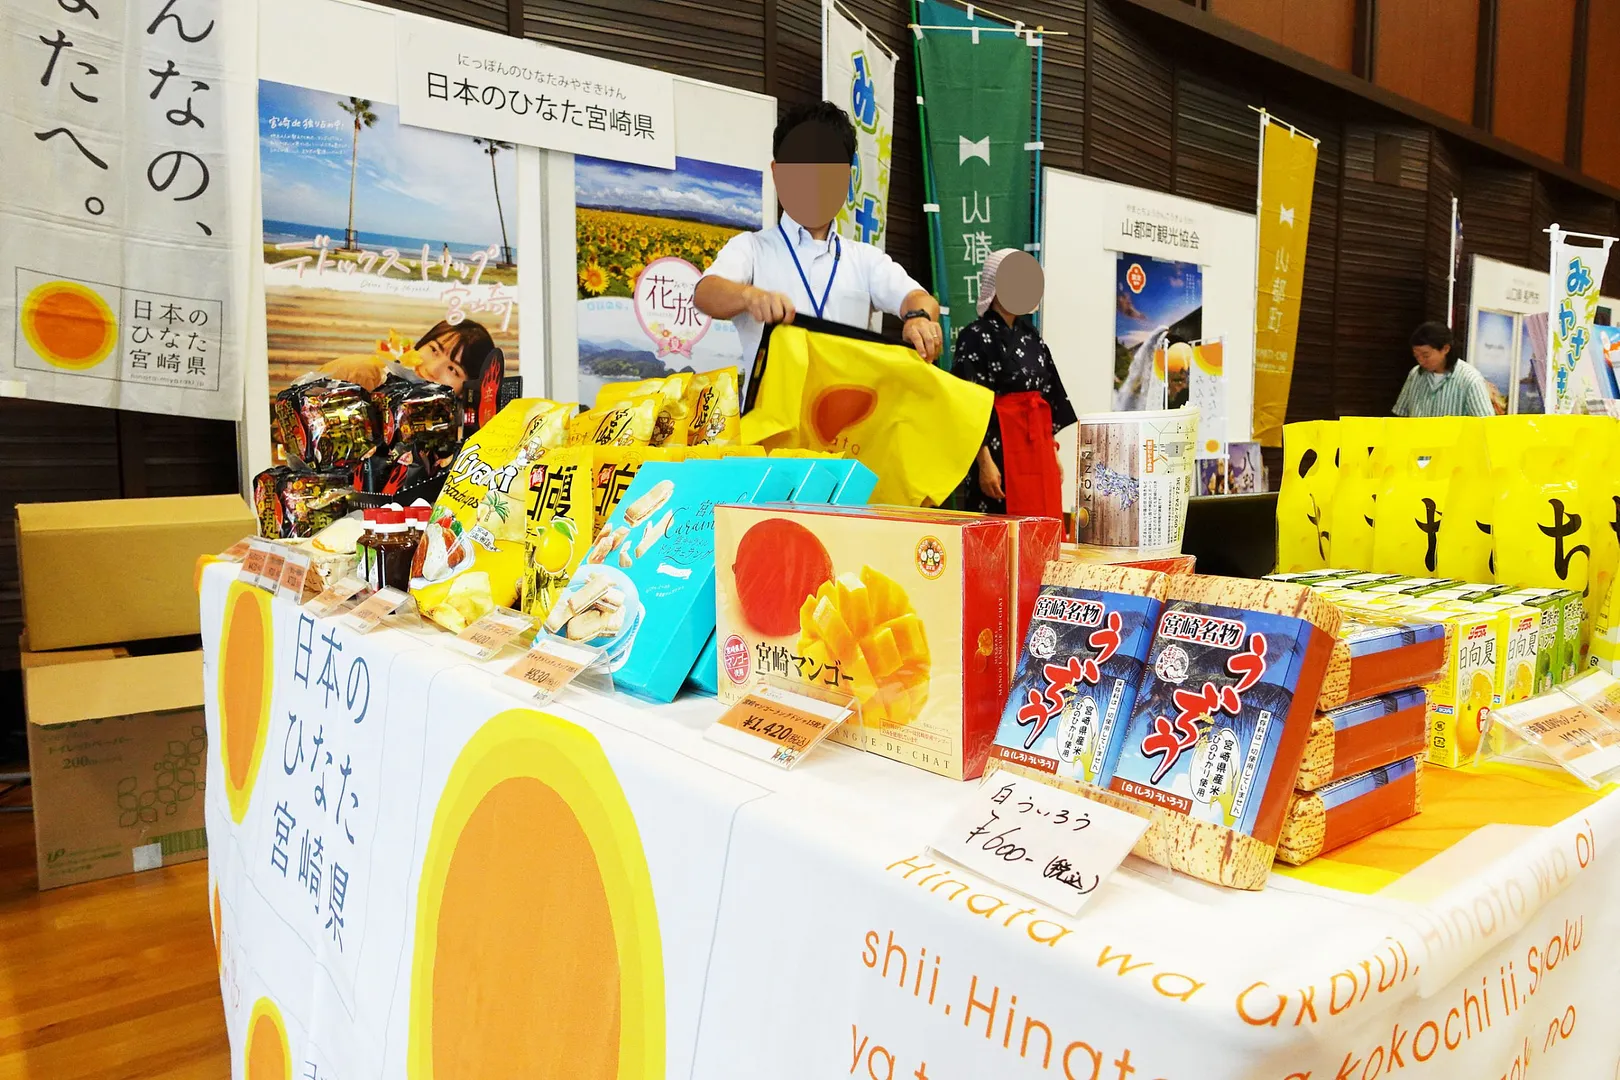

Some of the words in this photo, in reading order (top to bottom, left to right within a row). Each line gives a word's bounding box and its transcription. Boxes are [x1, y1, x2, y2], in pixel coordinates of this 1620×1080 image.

[427, 72, 655, 140] 日本のひなた宮崎県
[1121, 218, 1200, 249] 山都町観光協会
[134, 300, 208, 326] 日本の
[440, 280, 514, 333] 宮崎
[646, 275, 703, 327] 花旅
[130, 349, 206, 376] 宮崎県
[132, 325, 207, 352] ひなた
[1084, 439, 1092, 502] KONNE
[1036, 598, 1100, 623] 宮崎名物
[1162, 615, 1242, 645] 宮崎名物
[294, 612, 370, 725] 日本の
[725, 652, 748, 669] マンゴー
[755, 641, 854, 687] 宮崎マンゴー
[1459, 637, 1496, 670] 日向夏
[1508, 630, 1539, 661] 日向夏
[886, 742, 902, 755] DE
[912, 750, 950, 769] CHAT
[1062, 702, 1083, 758] ひのひかり使用
[1073, 705, 1094, 756] 宮崎県産米
[284, 710, 360, 845] ひなた
[1196, 735, 1221, 797] ひのひかり使用
[1209, 739, 1234, 796] 宮崎県産米
[1231, 713, 1270, 815] 保存料は一切使用していません
[271, 800, 349, 953] 宮崎県
[885, 854, 1074, 948] Hinata
[1096, 944, 1207, 1003] wa
[1543, 1004, 1576, 1053] no
